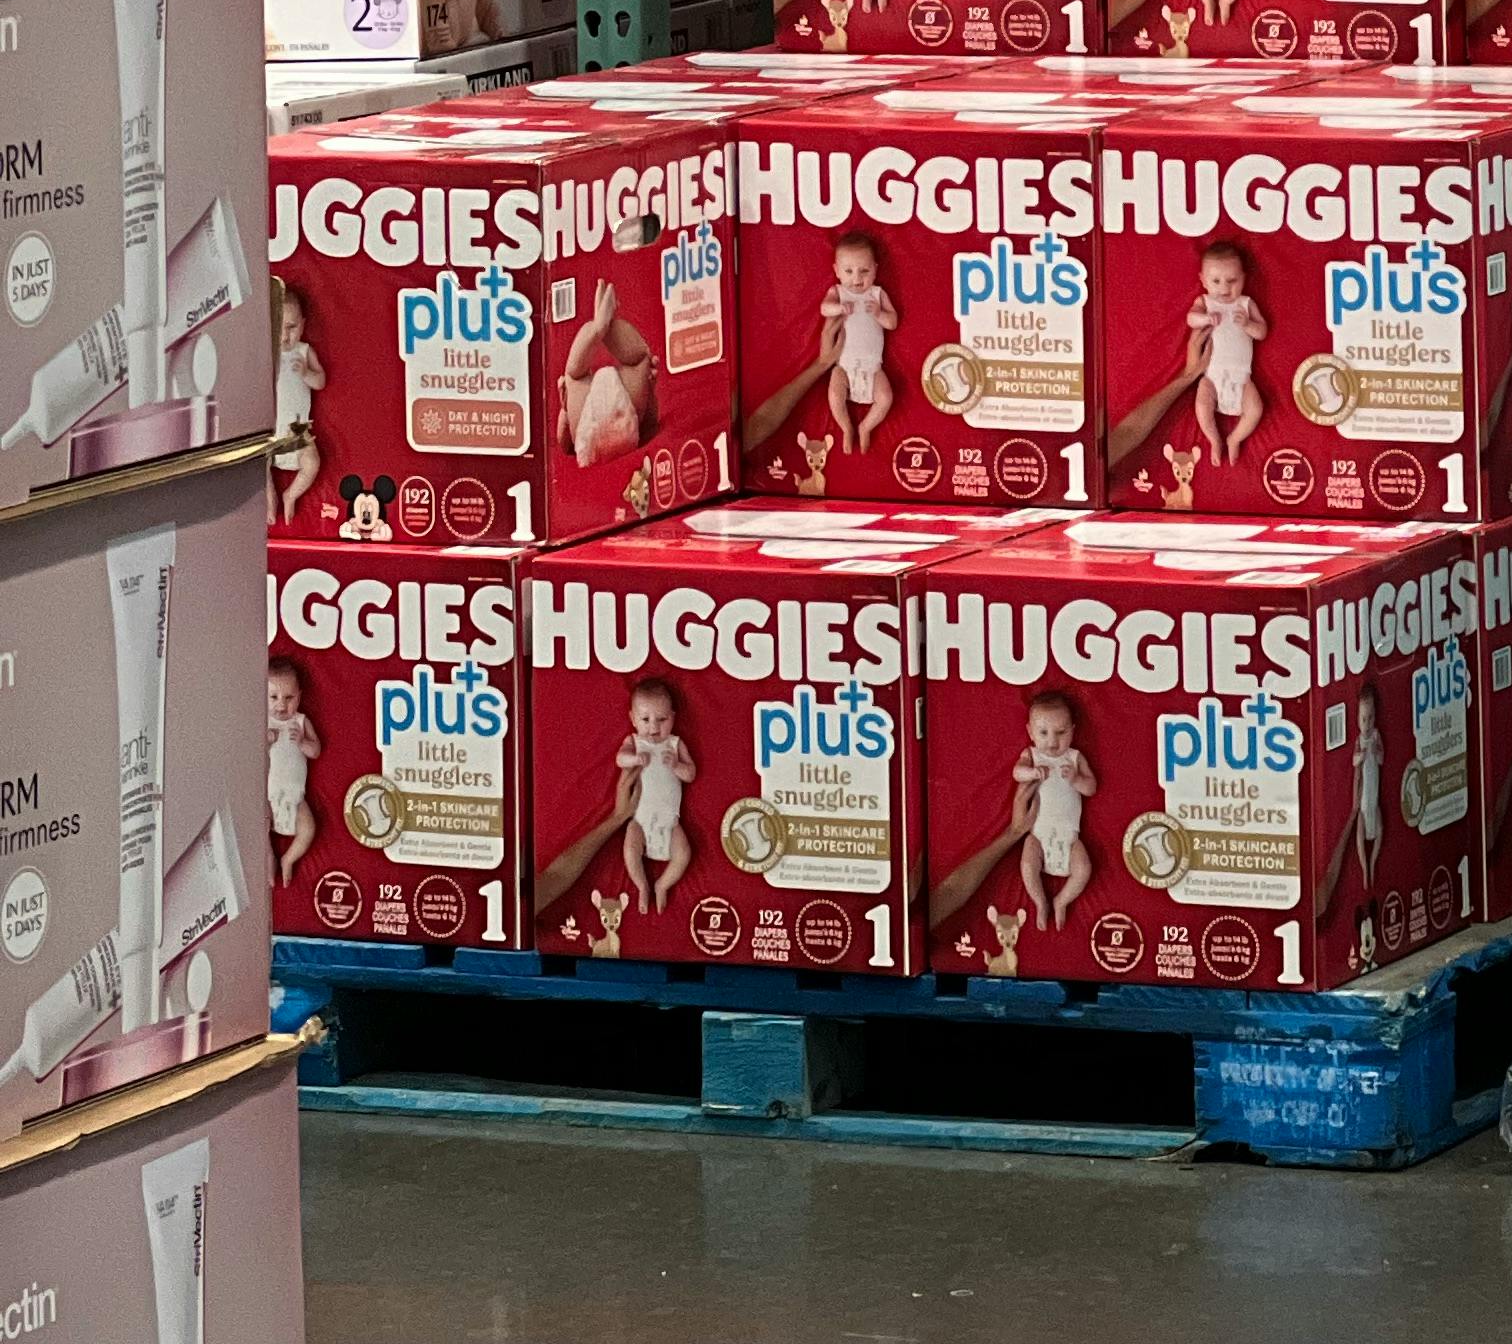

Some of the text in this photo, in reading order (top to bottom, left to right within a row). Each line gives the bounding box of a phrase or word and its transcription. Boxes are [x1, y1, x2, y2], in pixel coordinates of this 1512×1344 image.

[426, 3, 449, 27] 174
[3, 182, 84, 215] firmness
[738, 141, 1095, 237] HUGGIES
[1102, 150, 1473, 244] HUGGIES
[443, 349, 491, 369] little
[420, 370, 516, 393] snugglers
[448, 411, 472, 422] DAY
[485, 412, 515, 423] NIGHT
[448, 424, 517, 436] PROTECTION
[404, 488, 430, 504] 192
[506, 481, 536, 541] 1
[532, 580, 902, 683] HUGGIES
[927, 592, 1311, 698] HUGGIES
[1204, 778, 1260, 799] little
[1178, 800, 1288, 826] snugglers
[1193, 838, 1295, 854] 2-in-1 SKINCARE
[1203, 856, 1284, 869] PROTECTION
[1163, 927, 1189, 942] 192
[1158, 945, 1193, 955] DIAPERS
[1274, 920, 1305, 984] 1
